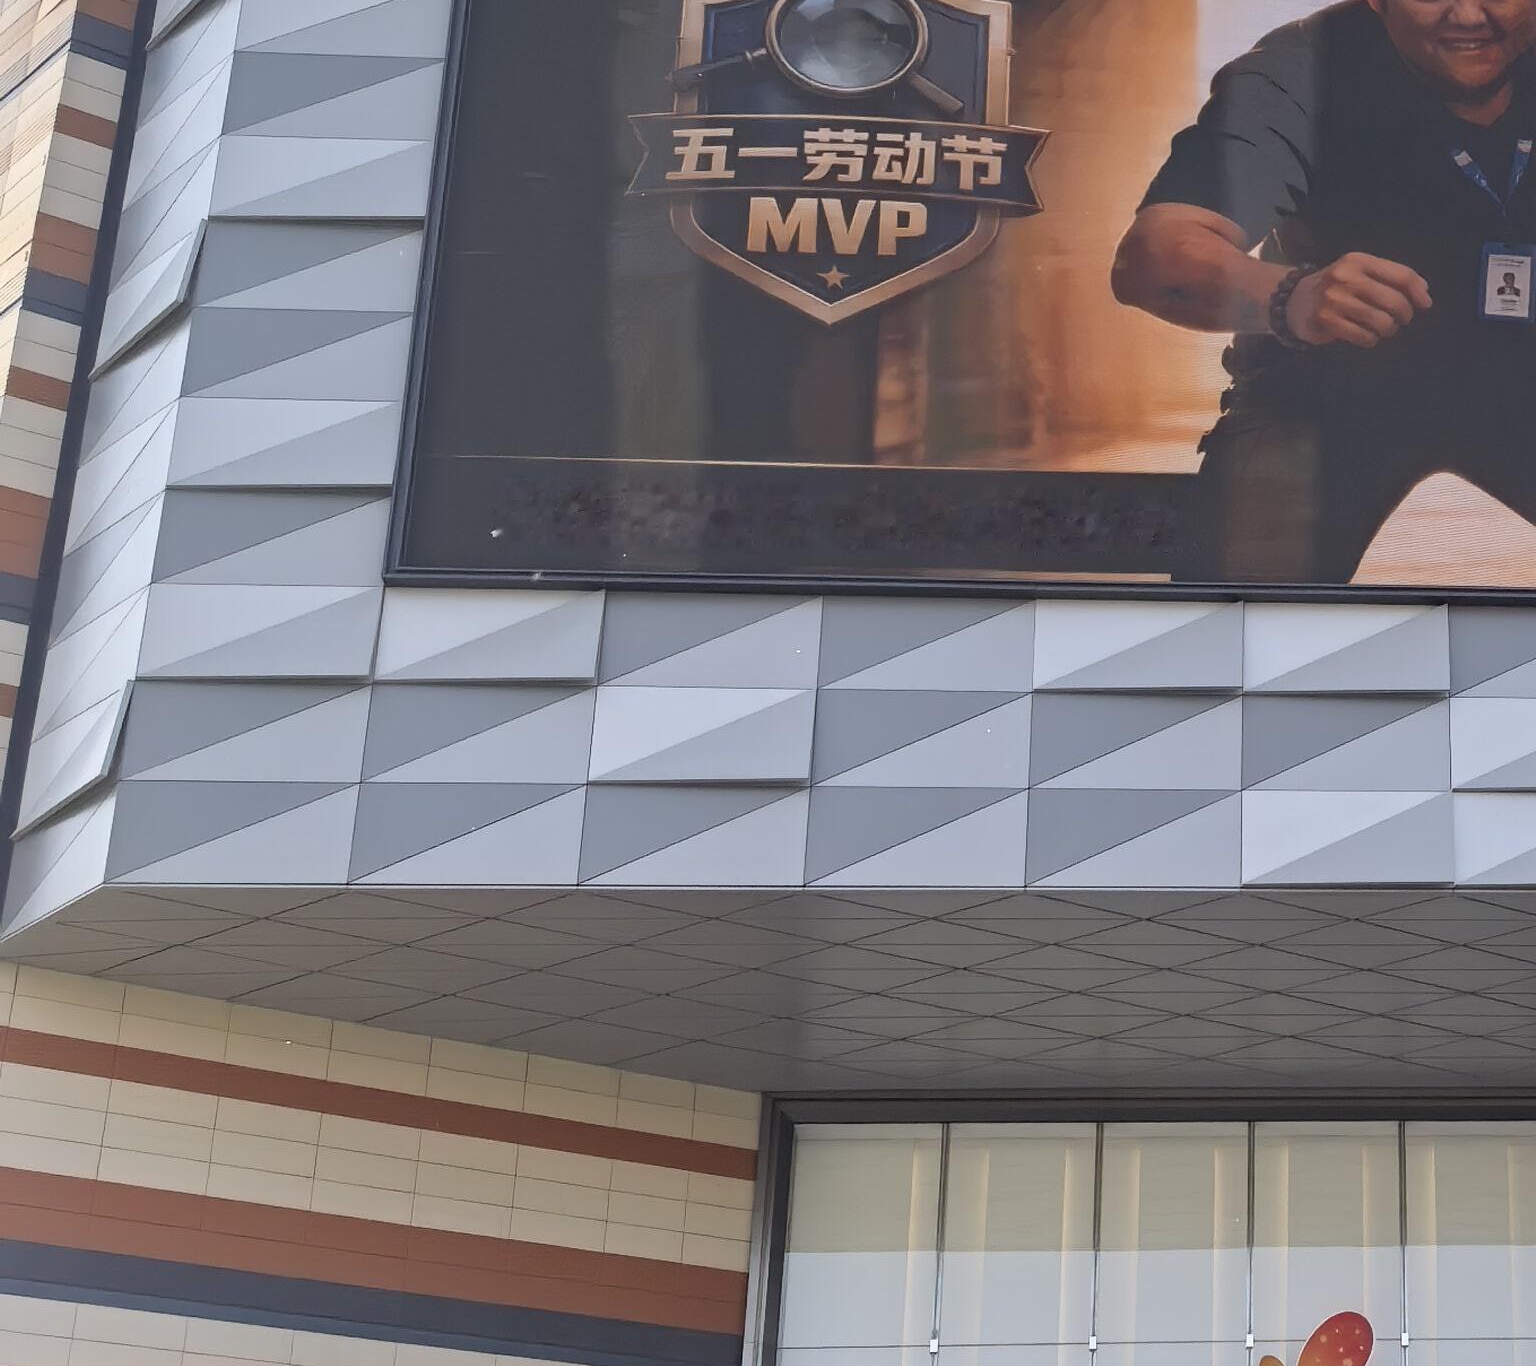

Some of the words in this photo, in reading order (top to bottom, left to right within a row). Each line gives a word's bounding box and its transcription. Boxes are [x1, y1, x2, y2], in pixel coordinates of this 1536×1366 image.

[665, 127, 1008, 191] 五一劳动节
[747, 196, 928, 256] MVP
